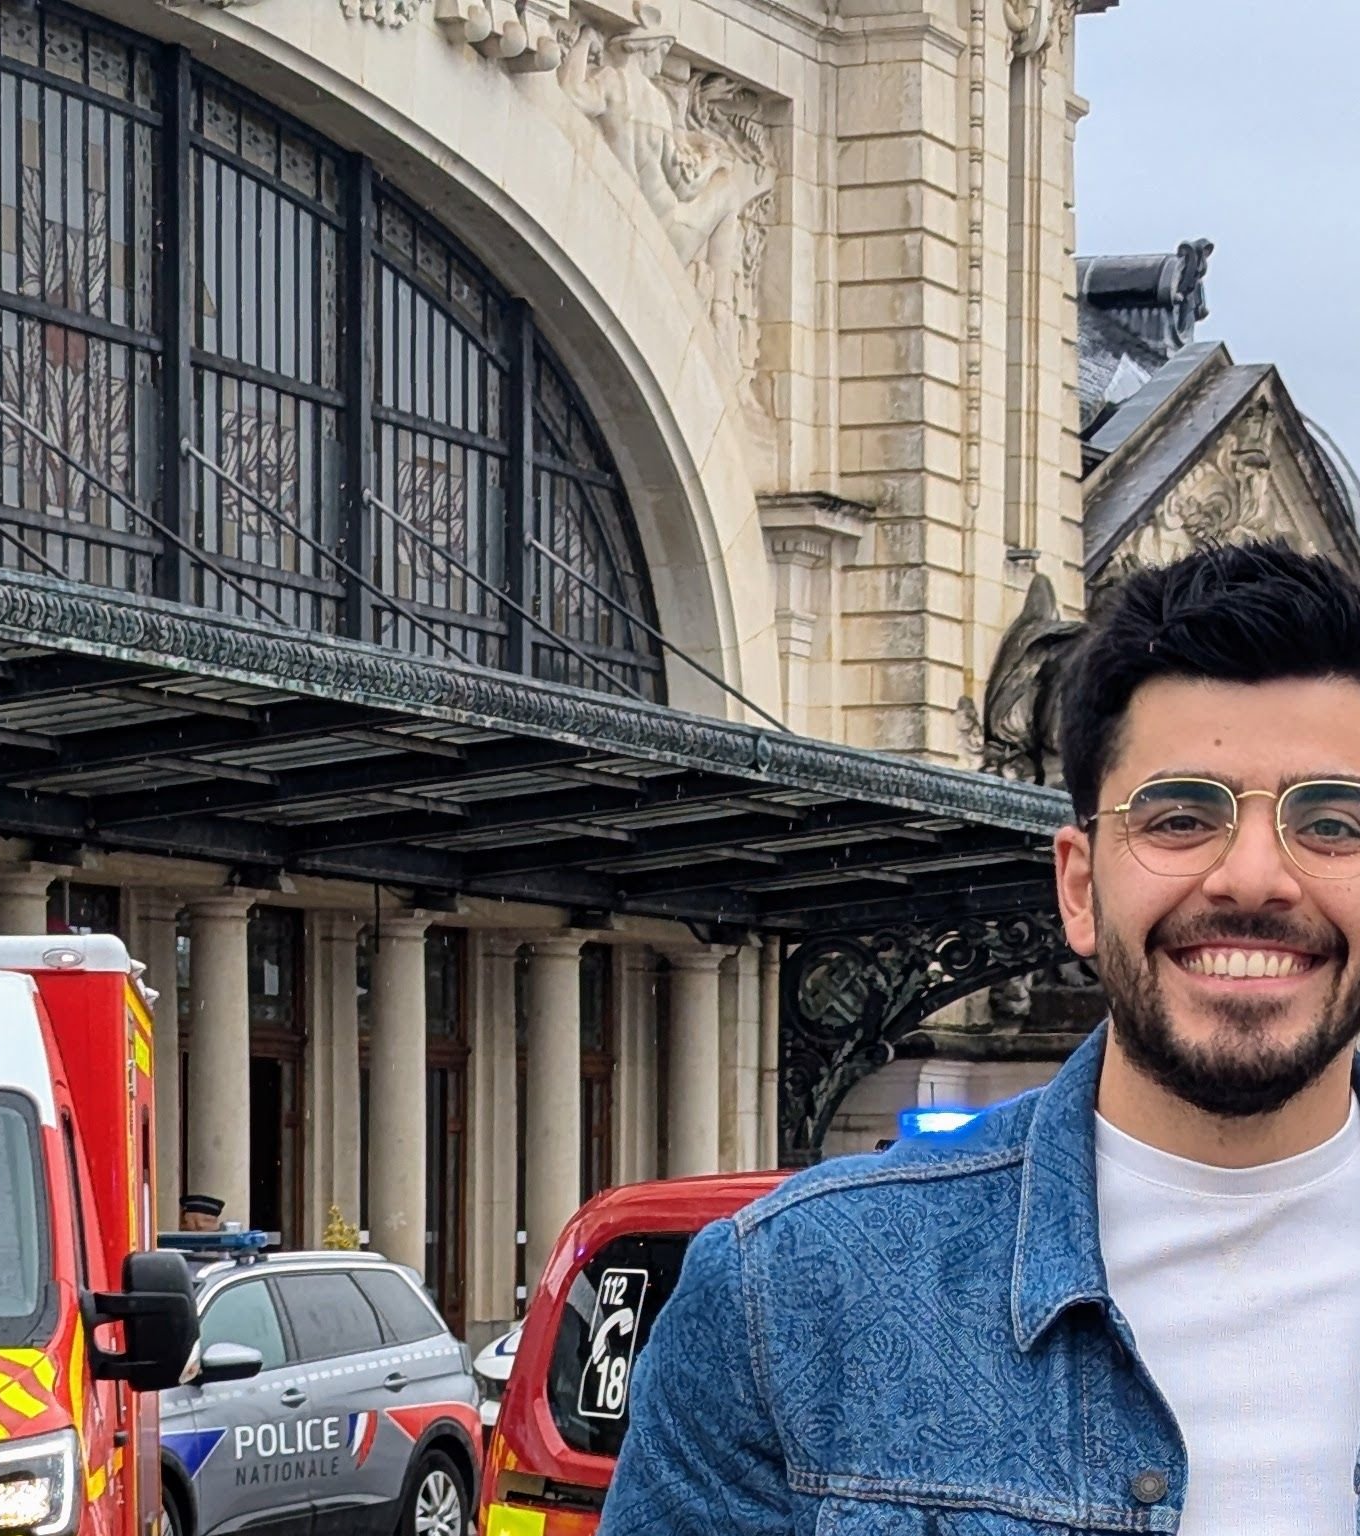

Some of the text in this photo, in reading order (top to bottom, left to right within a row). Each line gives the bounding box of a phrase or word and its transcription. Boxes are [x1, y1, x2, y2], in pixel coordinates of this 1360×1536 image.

[602, 1275, 628, 1305] 112
[596, 1355, 626, 1410] 18
[234, 1416, 340, 1460] POLICE
[235, 1456, 339, 1486] NATIONALE
